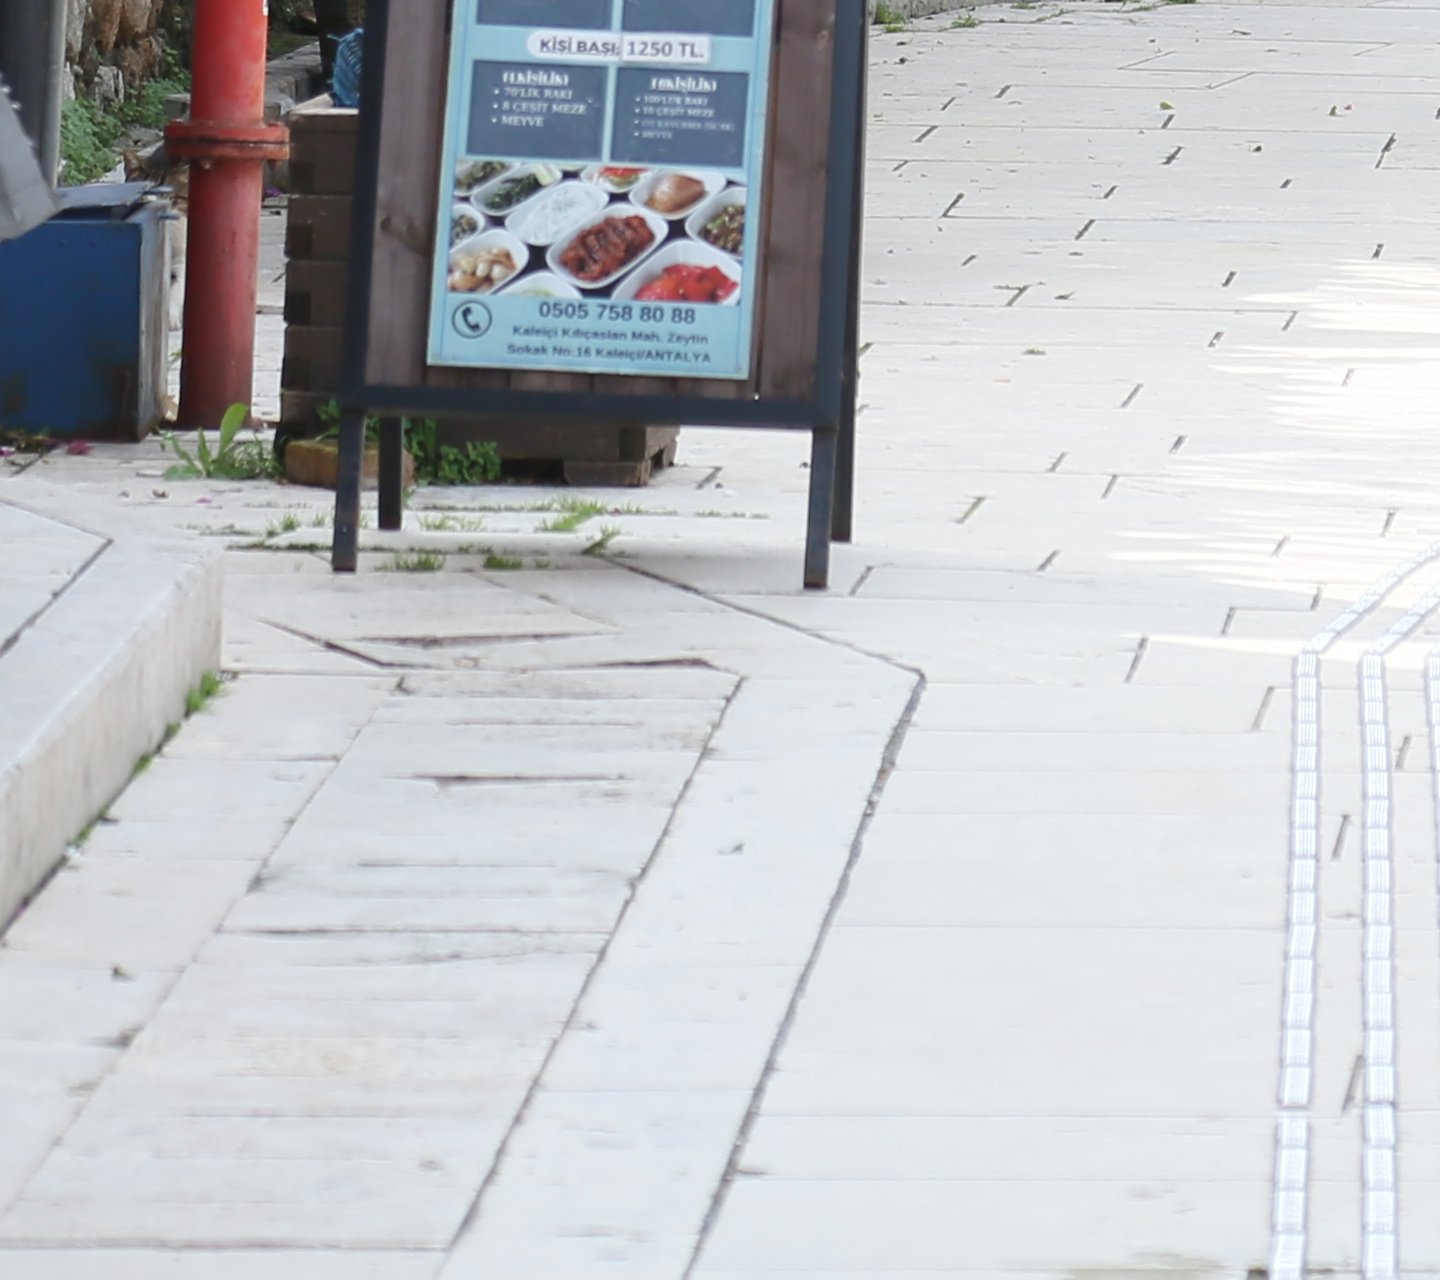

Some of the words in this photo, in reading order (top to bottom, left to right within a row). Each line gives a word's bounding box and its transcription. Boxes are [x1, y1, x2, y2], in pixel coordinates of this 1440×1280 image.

[539, 39, 574, 56] KİŞİ
[626, 41, 674, 58] 1250
[678, 42, 705, 58] TL.
[551, 103, 587, 116] MEZE
[501, 115, 545, 128] MEYVE
[539, 301, 589, 319] 0505
[596, 303, 633, 321] 758
[639, 305, 664, 323] 80
[670, 307, 696, 324] 88
[507, 342, 548, 356] Sokak
